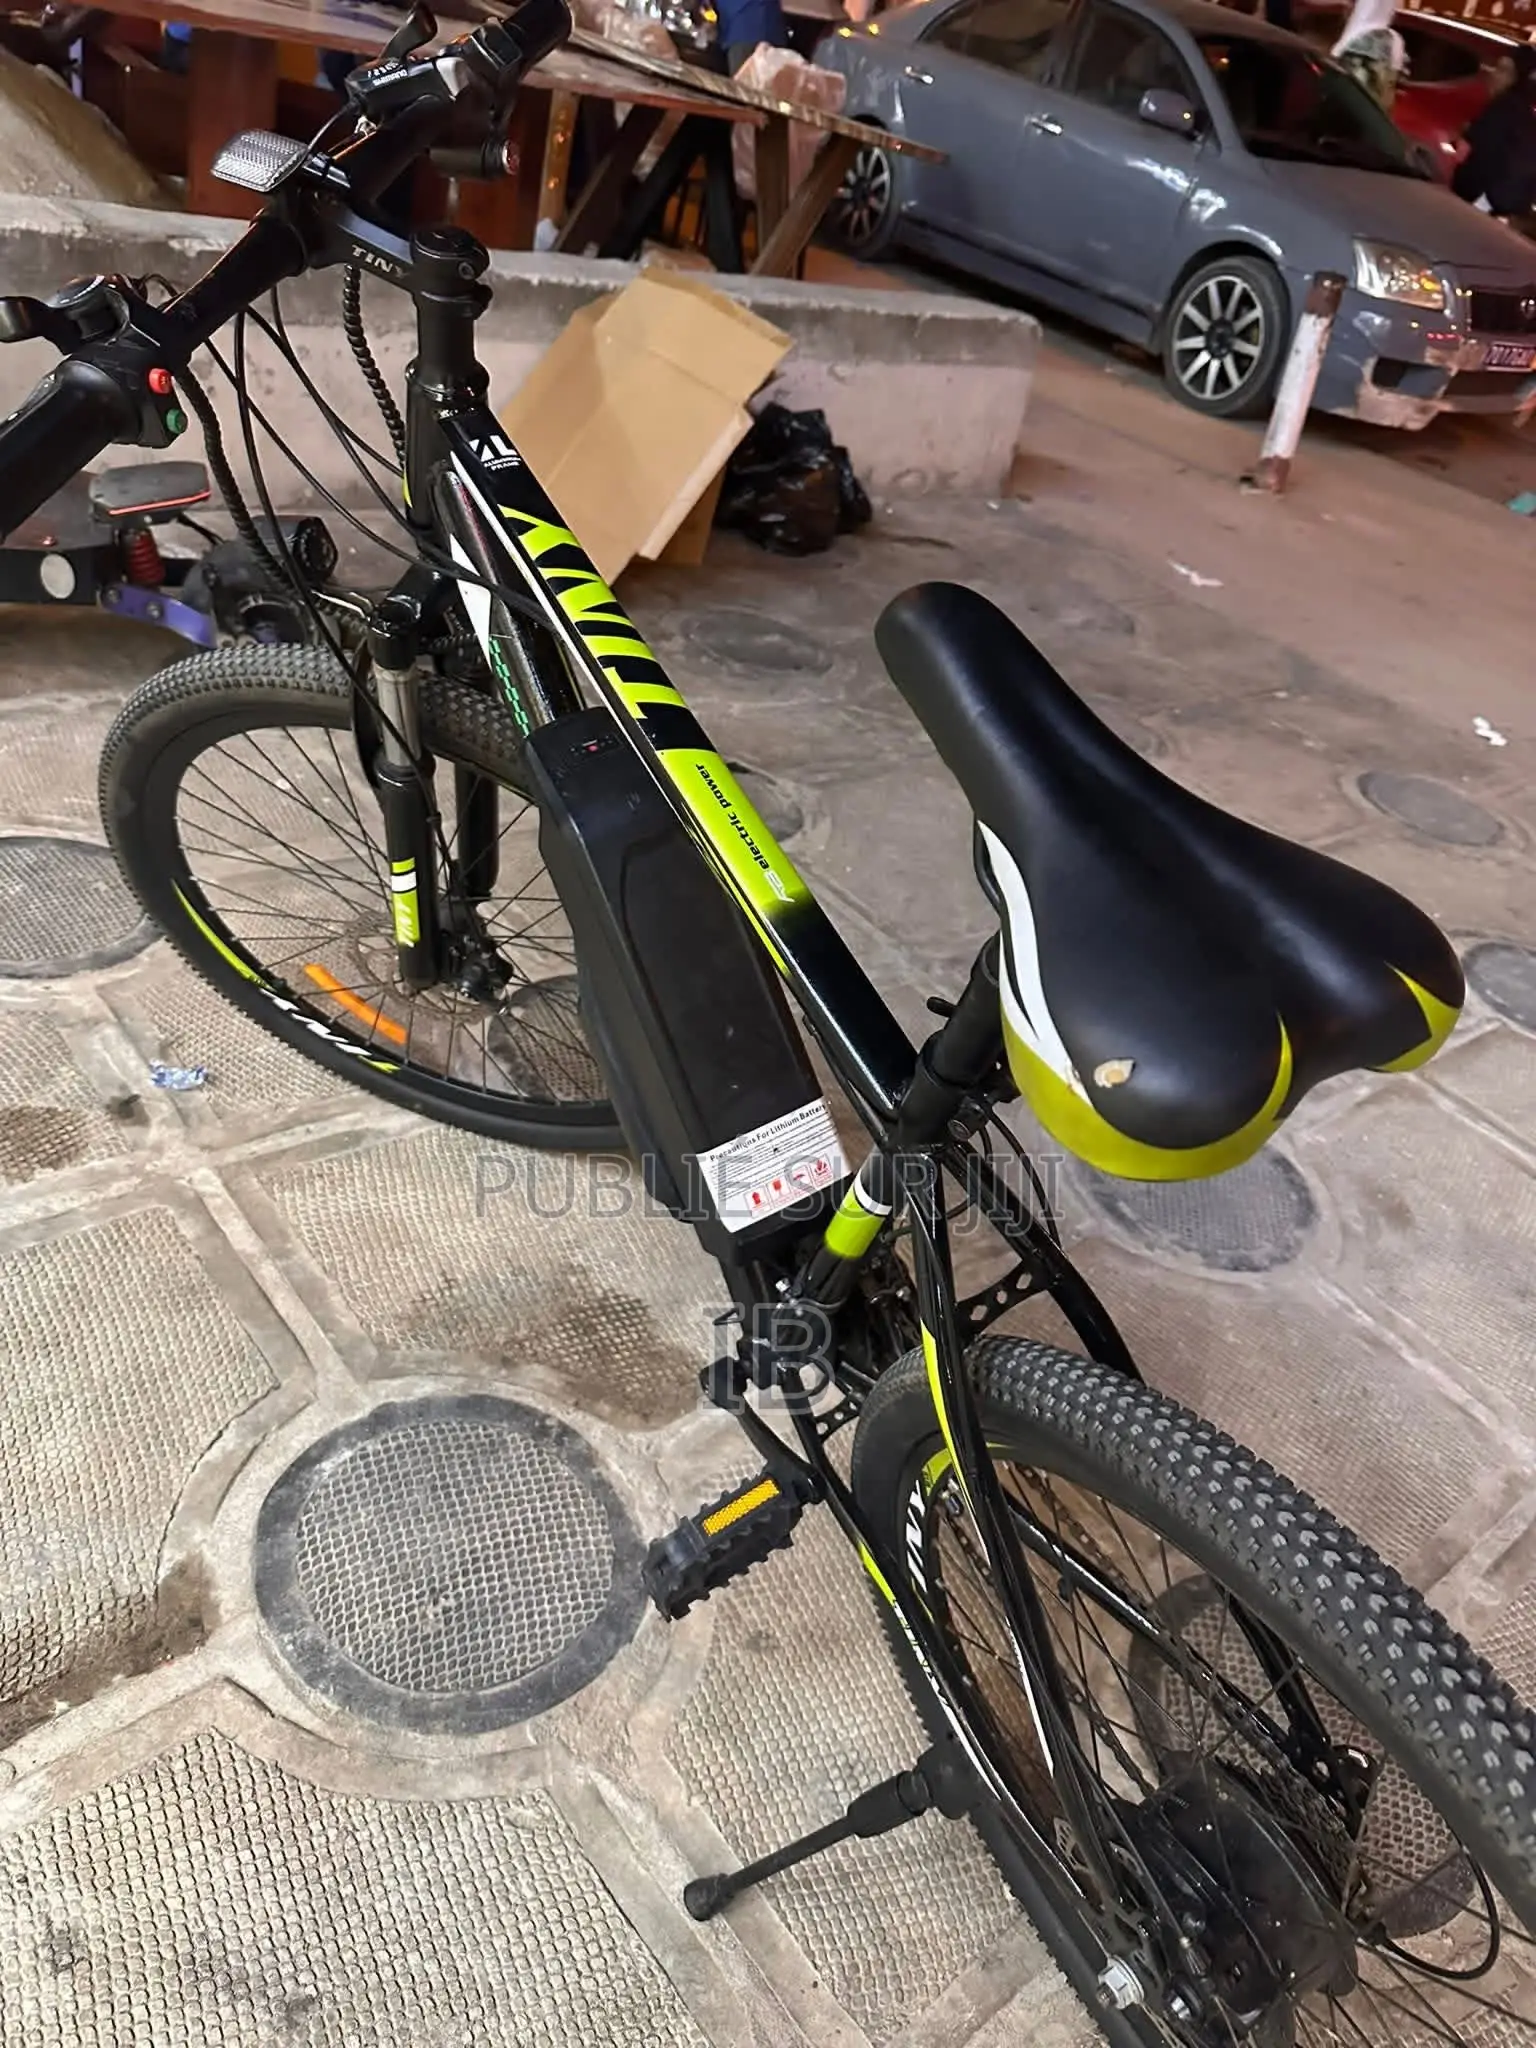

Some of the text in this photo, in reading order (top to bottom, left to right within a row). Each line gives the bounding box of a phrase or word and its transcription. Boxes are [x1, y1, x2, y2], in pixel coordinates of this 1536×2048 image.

[352, 244, 409, 279] TINY
[497, 503, 689, 719] TINY
[695, 763, 770, 870] electric power
[710, 1136, 756, 1162] Precautions
[757, 1130, 770, 1140] For
[770, 1116, 800, 1135] Lithium
